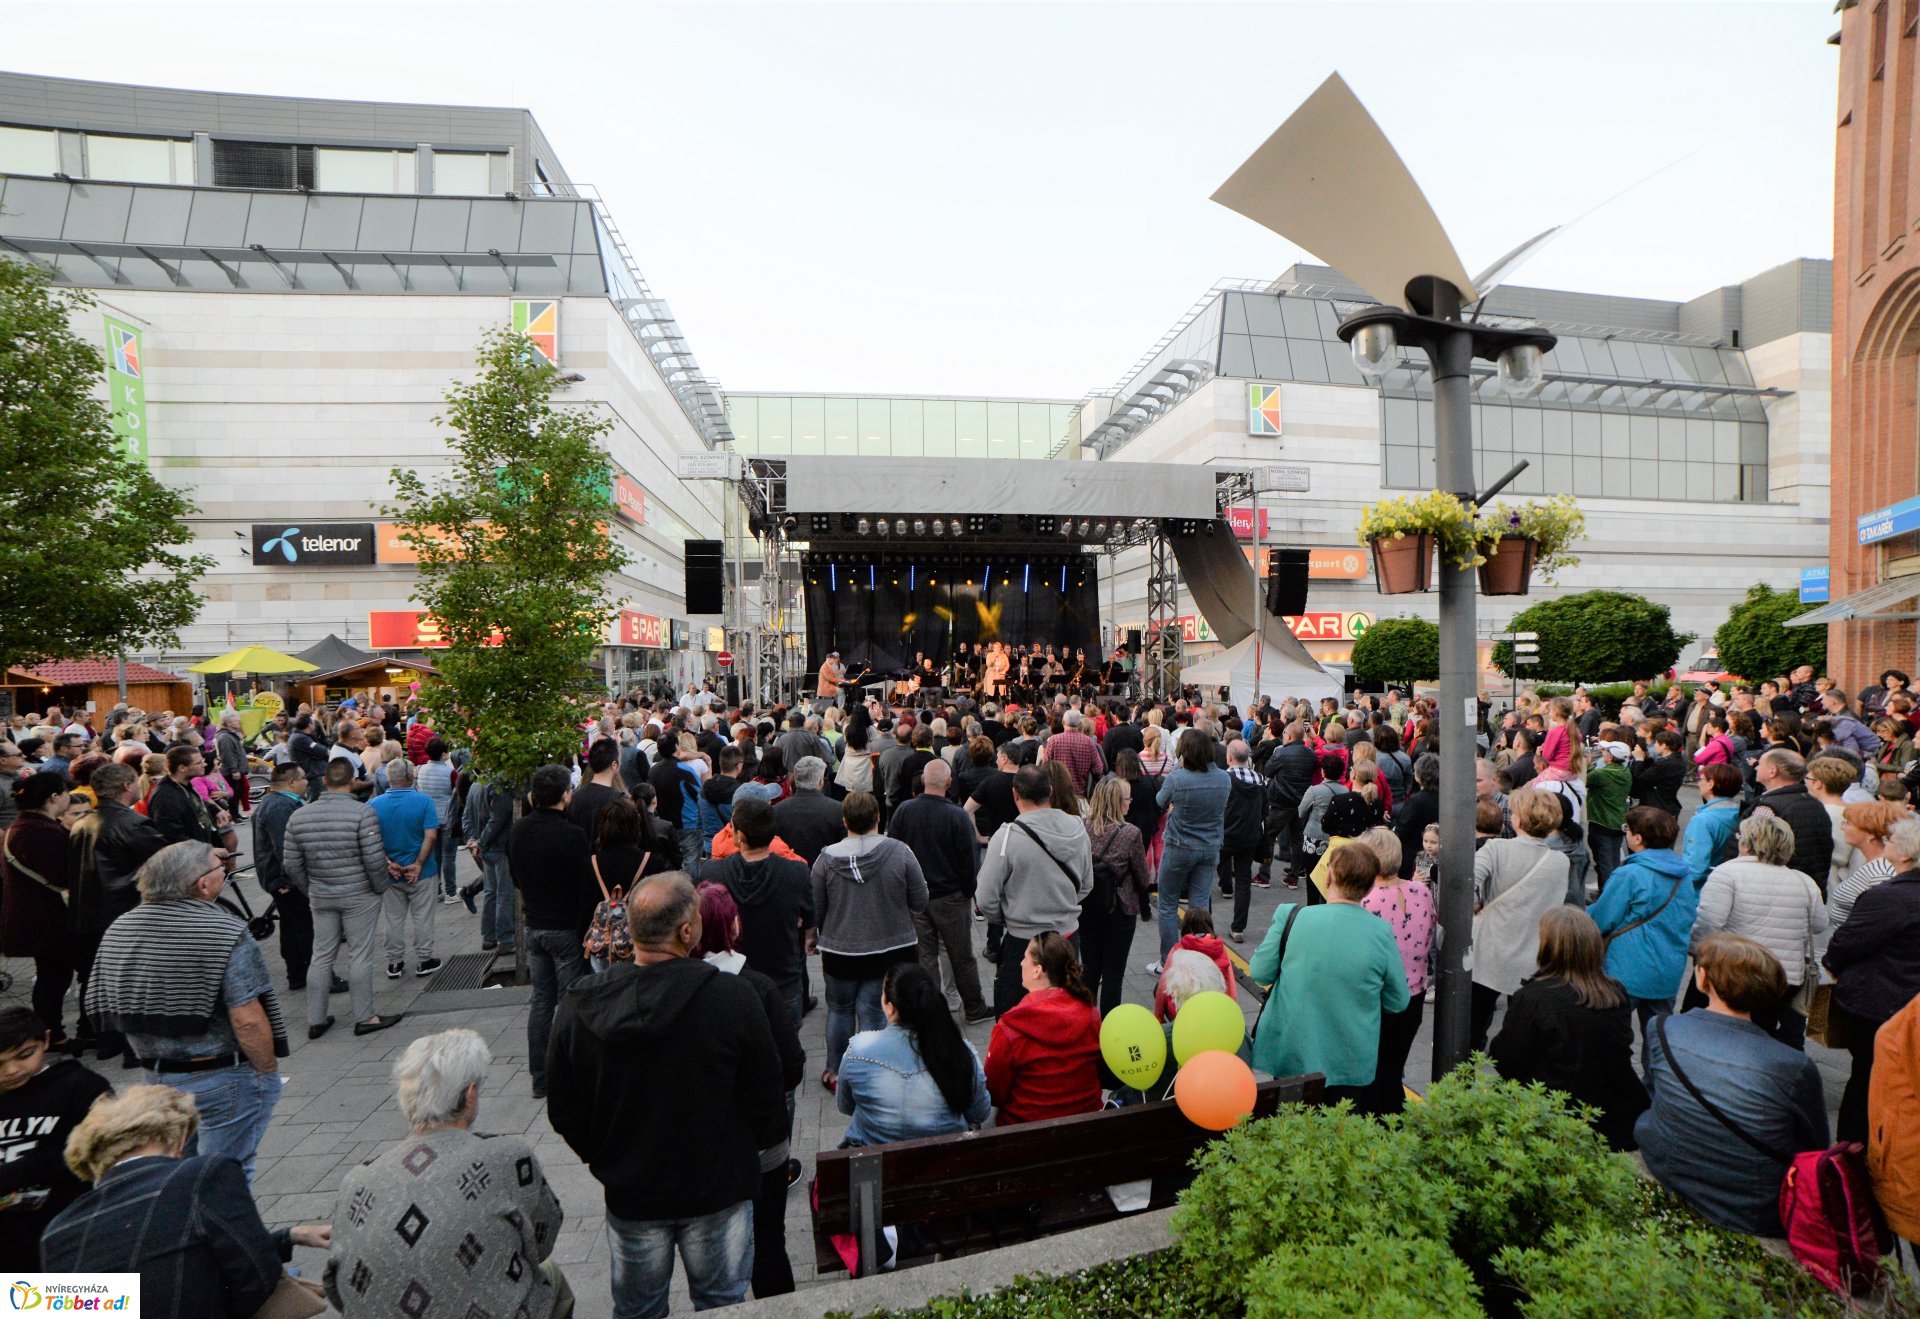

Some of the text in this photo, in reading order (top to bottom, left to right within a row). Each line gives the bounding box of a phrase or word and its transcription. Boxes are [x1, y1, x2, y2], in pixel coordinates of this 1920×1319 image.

[124, 385, 141, 455] KOR
[1229, 516, 1260, 530] Hervi
[1866, 517, 1894, 539] TAKARÉK
[301, 535, 362, 552] telenor
[1309, 559, 1341, 569] xpert
[1806, 569, 1826, 577] ATM
[631, 616, 660, 642] SPAR
[1284, 616, 1340, 636] PAR
[253, 698, 281, 707] MOJITO
[0, 1116, 60, 1138] KLYN
